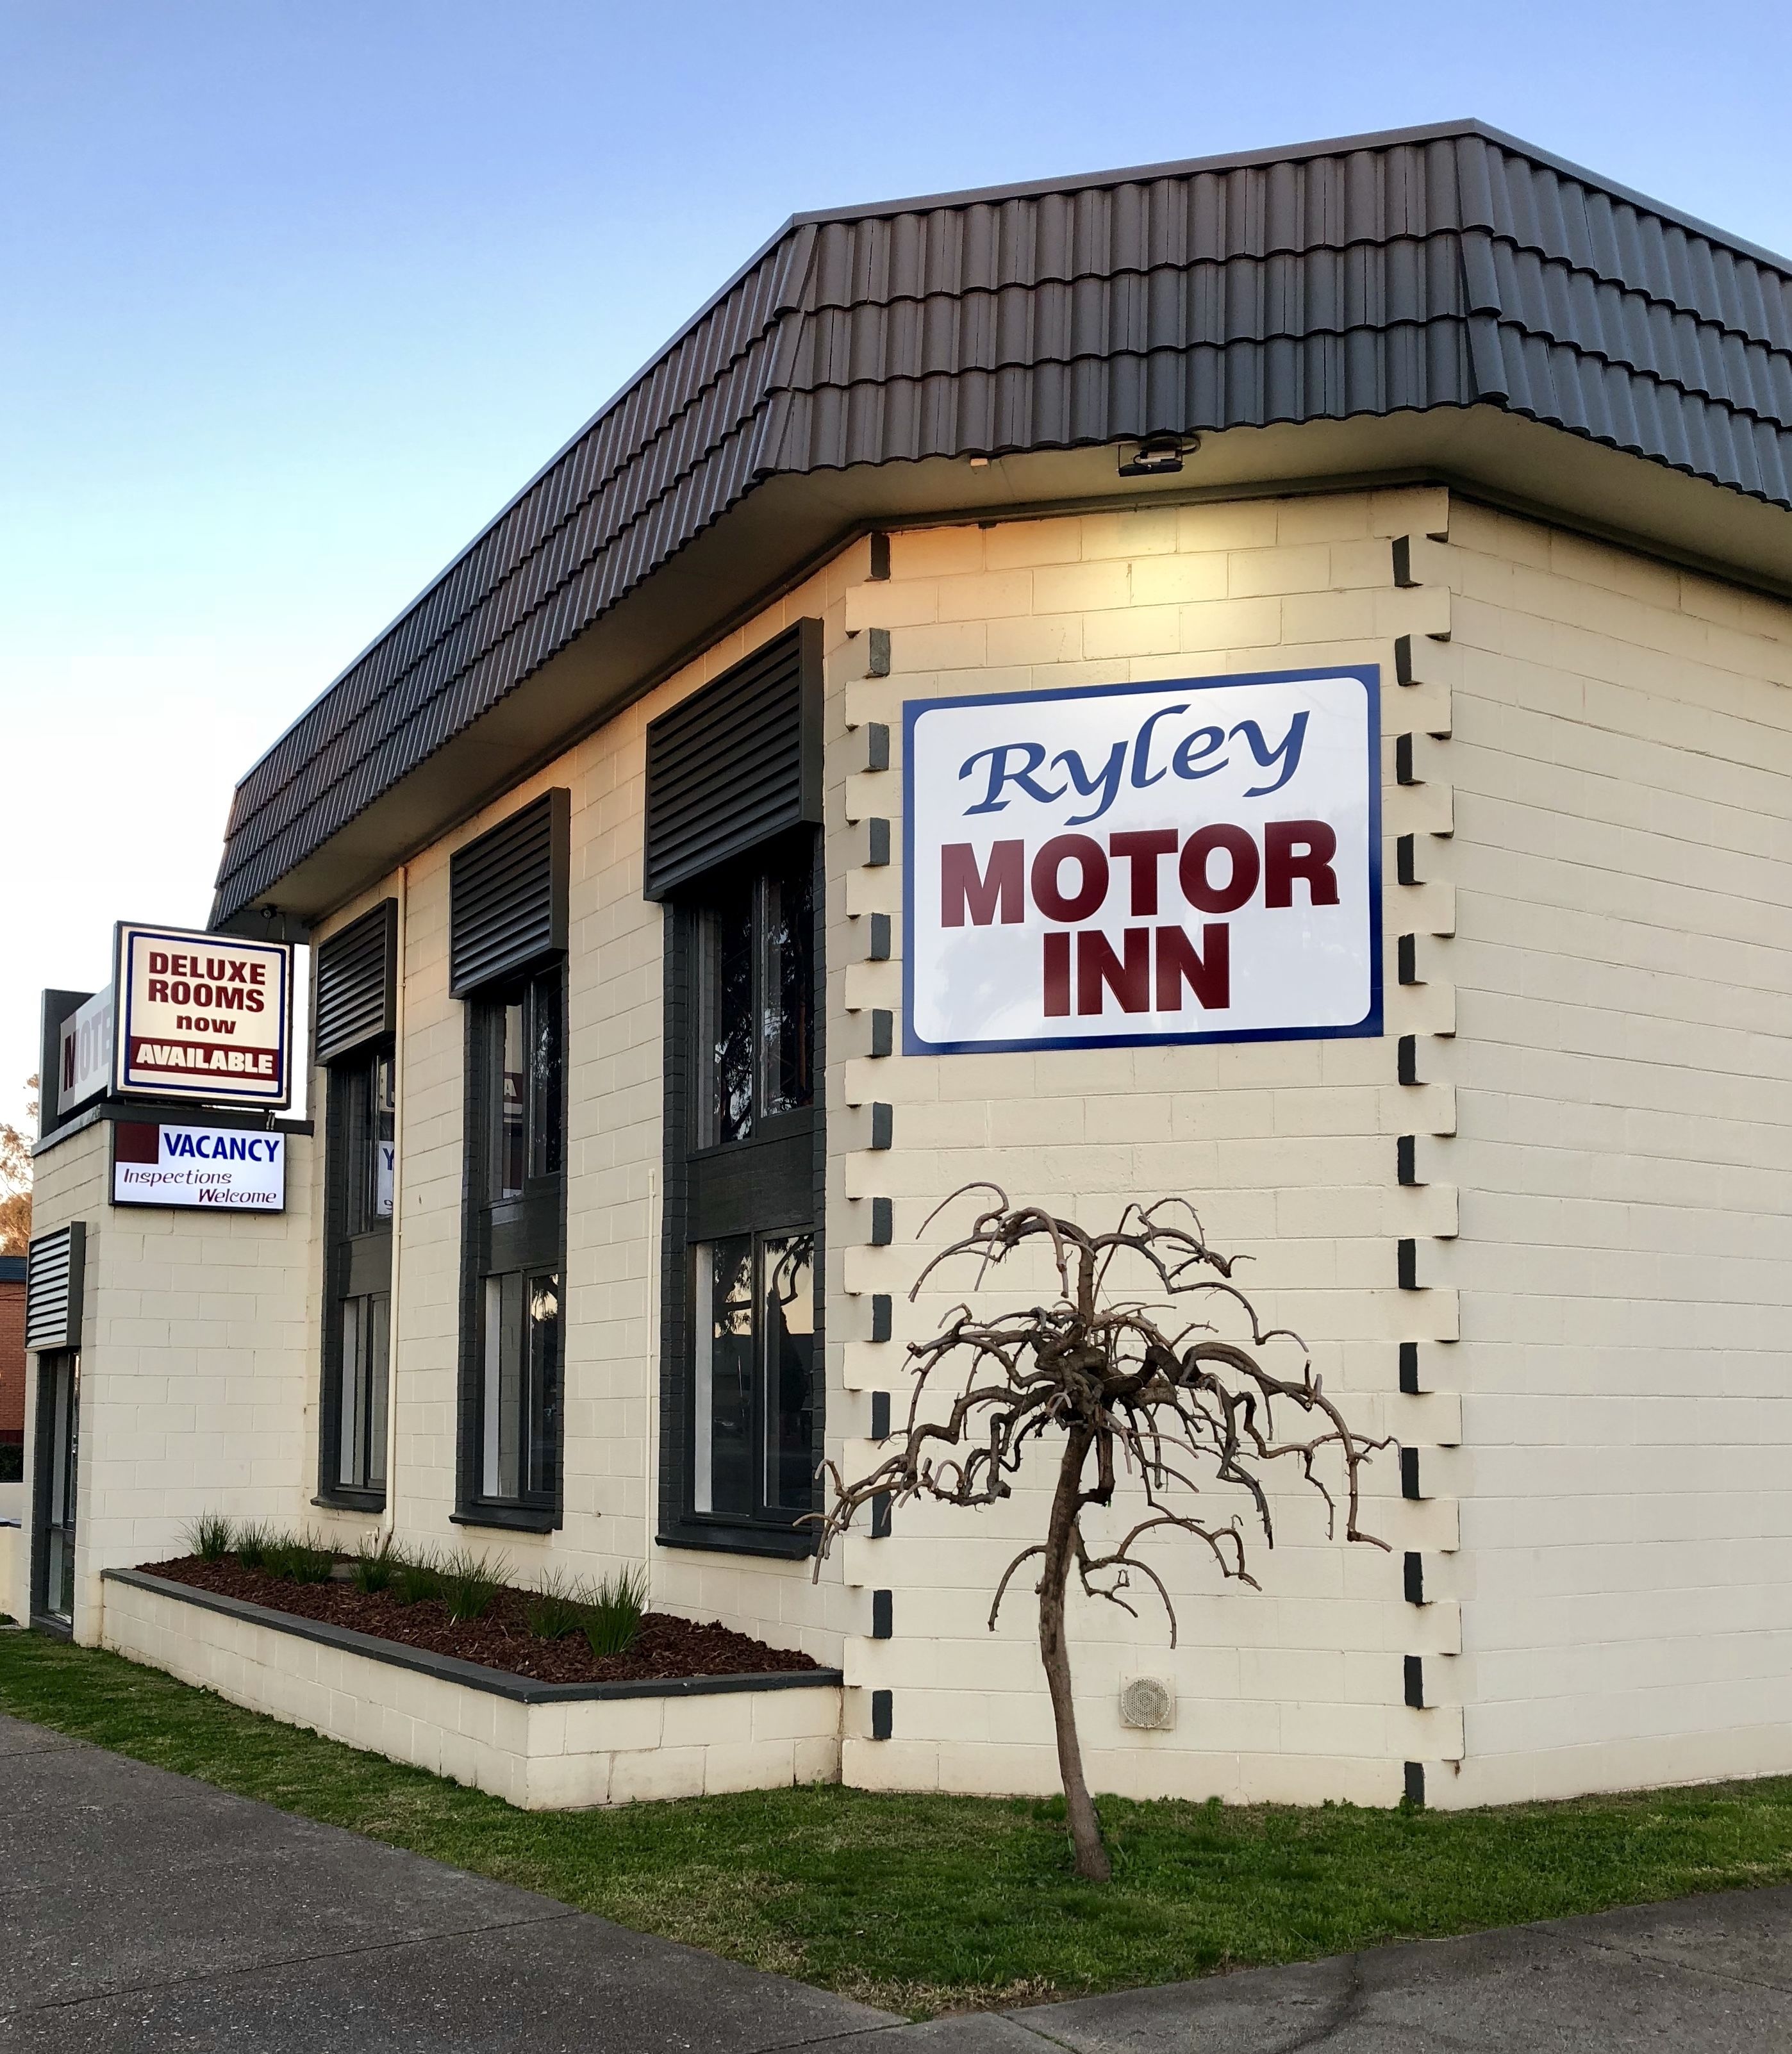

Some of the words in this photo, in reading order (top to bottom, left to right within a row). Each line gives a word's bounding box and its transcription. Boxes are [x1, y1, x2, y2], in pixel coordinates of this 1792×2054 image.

[958, 704, 1311, 825] Ryley
[941, 820, 1340, 928] MOTOR
[149, 951, 266, 986] DELUXE
[1043, 922, 1230, 1016] INN
[148, 979, 265, 1013] ROOMS
[176, 1015, 236, 1034] now
[136, 1043, 273, 1075] AVAILABLE
[163, 1132, 279, 1163] VACANCY
[124, 1168, 232, 1187] Inspections
[198, 1188, 277, 1204] Welcome
